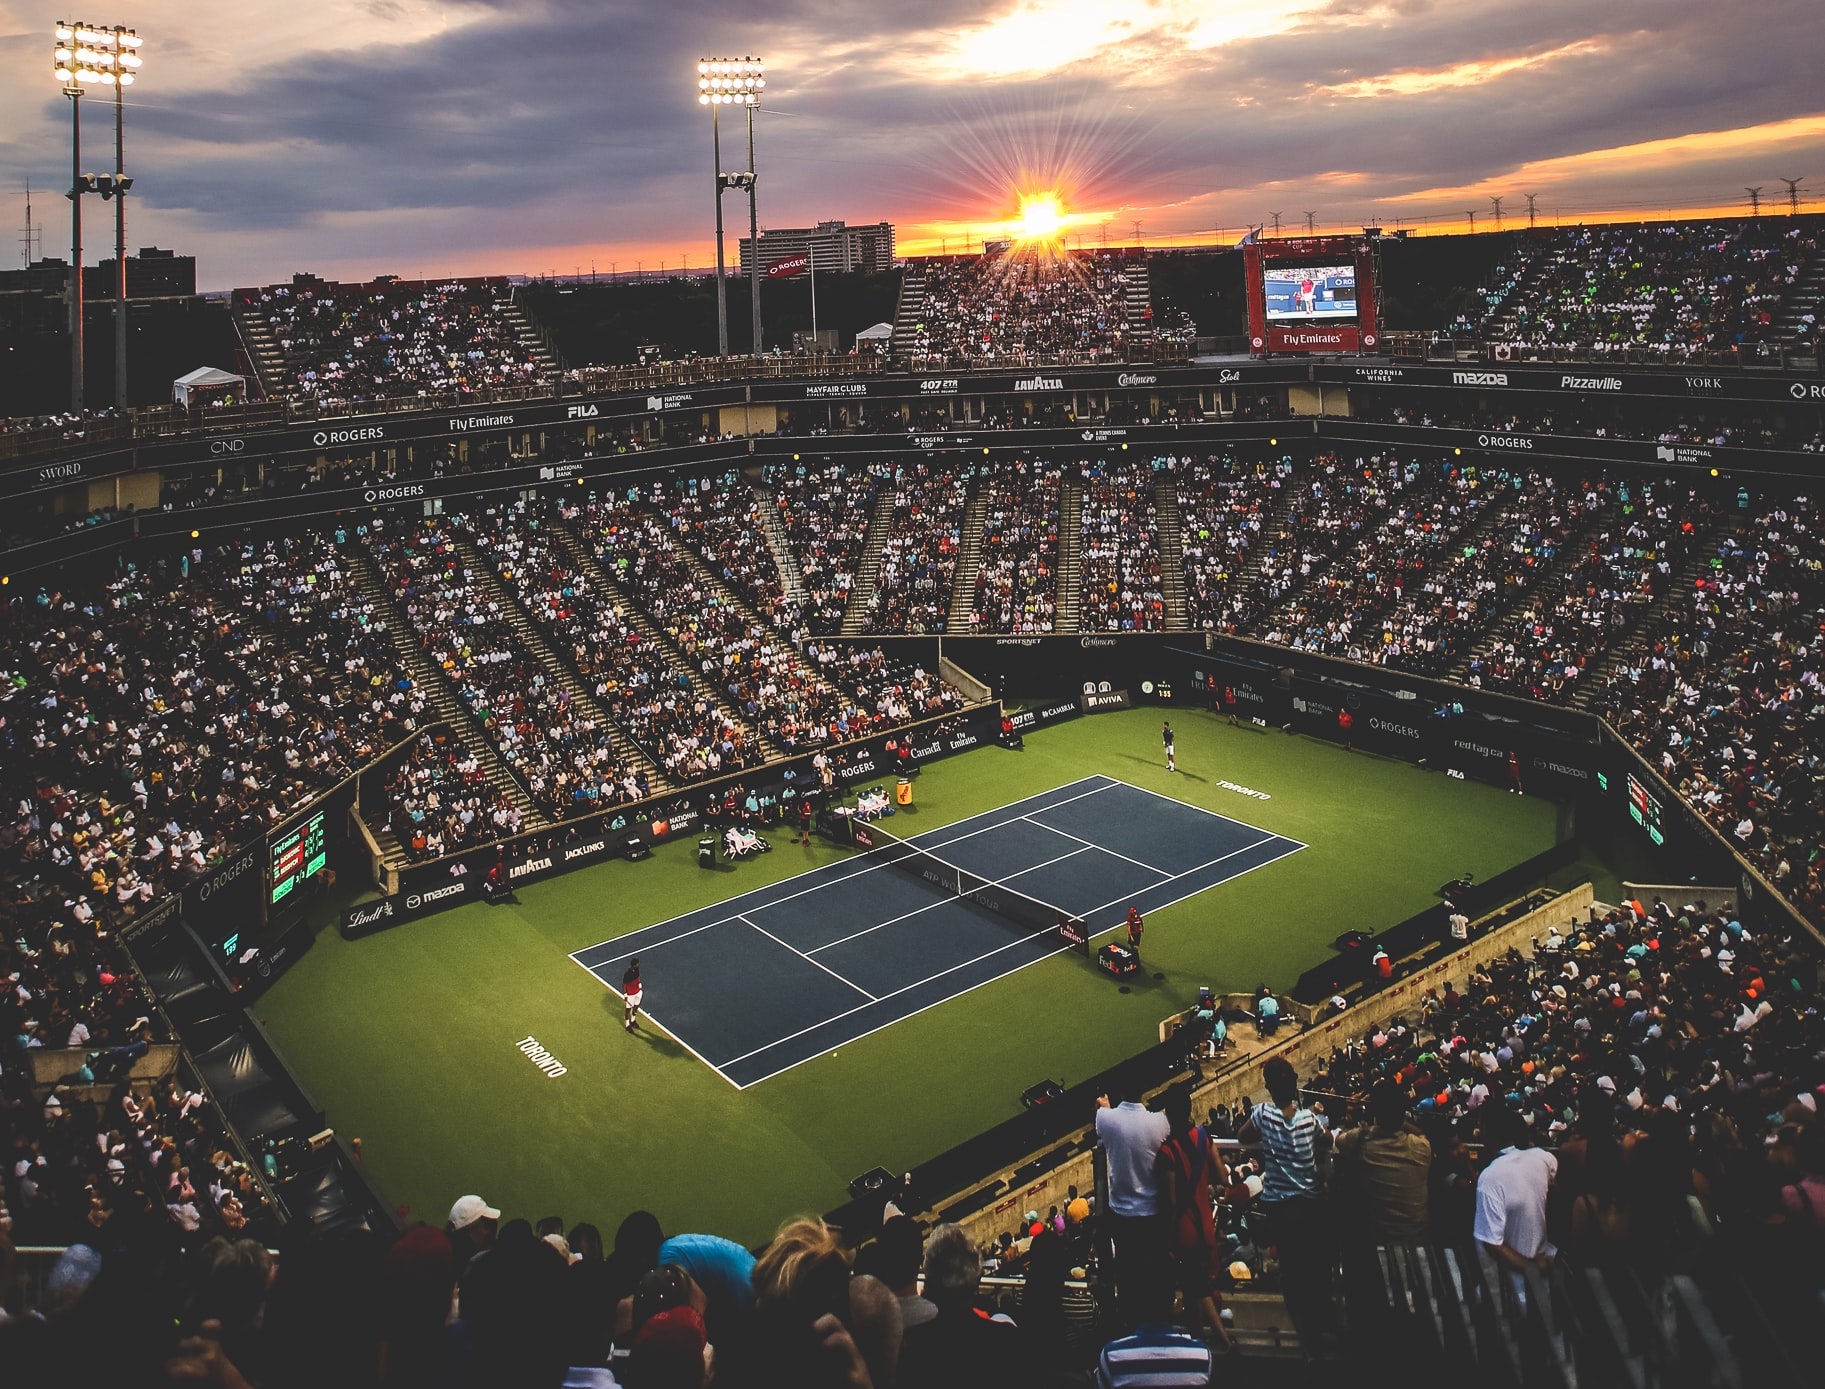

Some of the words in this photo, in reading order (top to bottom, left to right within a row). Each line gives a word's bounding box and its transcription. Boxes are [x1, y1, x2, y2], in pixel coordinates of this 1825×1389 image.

[1283, 334, 1299, 345] Fly
[1300, 333, 1341, 344] Emirates
[1355, 368, 1403, 376] CALIFORNIA
[806, 386, 840, 394] MAYFAIR
[840, 384, 867, 392] CLUBS
[920, 380, 941, 389] 407
[1561, 376, 1622, 390] Pizzaville
[1685, 377, 1722, 388] YORK
[664, 394, 692, 403] NATIONAL
[664, 401, 681, 409] BANK
[567, 404, 599, 419] FILA
[449, 419, 467, 432] Fly
[468, 415, 514, 429] Emirates
[330, 426, 384, 443] ROGERS
[210, 439, 245, 454] CND
[1490, 436, 1533, 449] ROGERS
[1677, 448, 1712, 457] NATIONAL
[1677, 455, 1698, 463] BANK
[39, 462, 81, 482] SWORD
[556, 463, 583, 472] NATIONAL
[556, 470, 572, 478] BANK
[378, 484, 424, 500] ROGERS
[996, 638, 1041, 646] SPORTSNET
[1097, 695, 1123, 705] AVIVA
[1252, 716, 1266, 727] FILA
[1381, 722, 1420, 739] ROGERS
[949, 735, 977, 750] Emirates
[909, 742, 942, 759] Canada
[840, 760, 875, 778] ROGERS
[1446, 768, 1465, 780] FILA
[1216, 780, 1272, 800] TORONTO
[669, 811, 699, 824] NATIONAL
[670, 820, 689, 831] BANK
[564, 846, 583, 861] JACK
[212, 852, 254, 892] ROGERS
[922, 870, 939, 882] ATP
[975, 893, 1000, 912] TOUR
[347, 906, 383, 928] Lindt
[1060, 927, 1082, 944] Emirates
[515, 1035, 568, 1078] TORONTO
